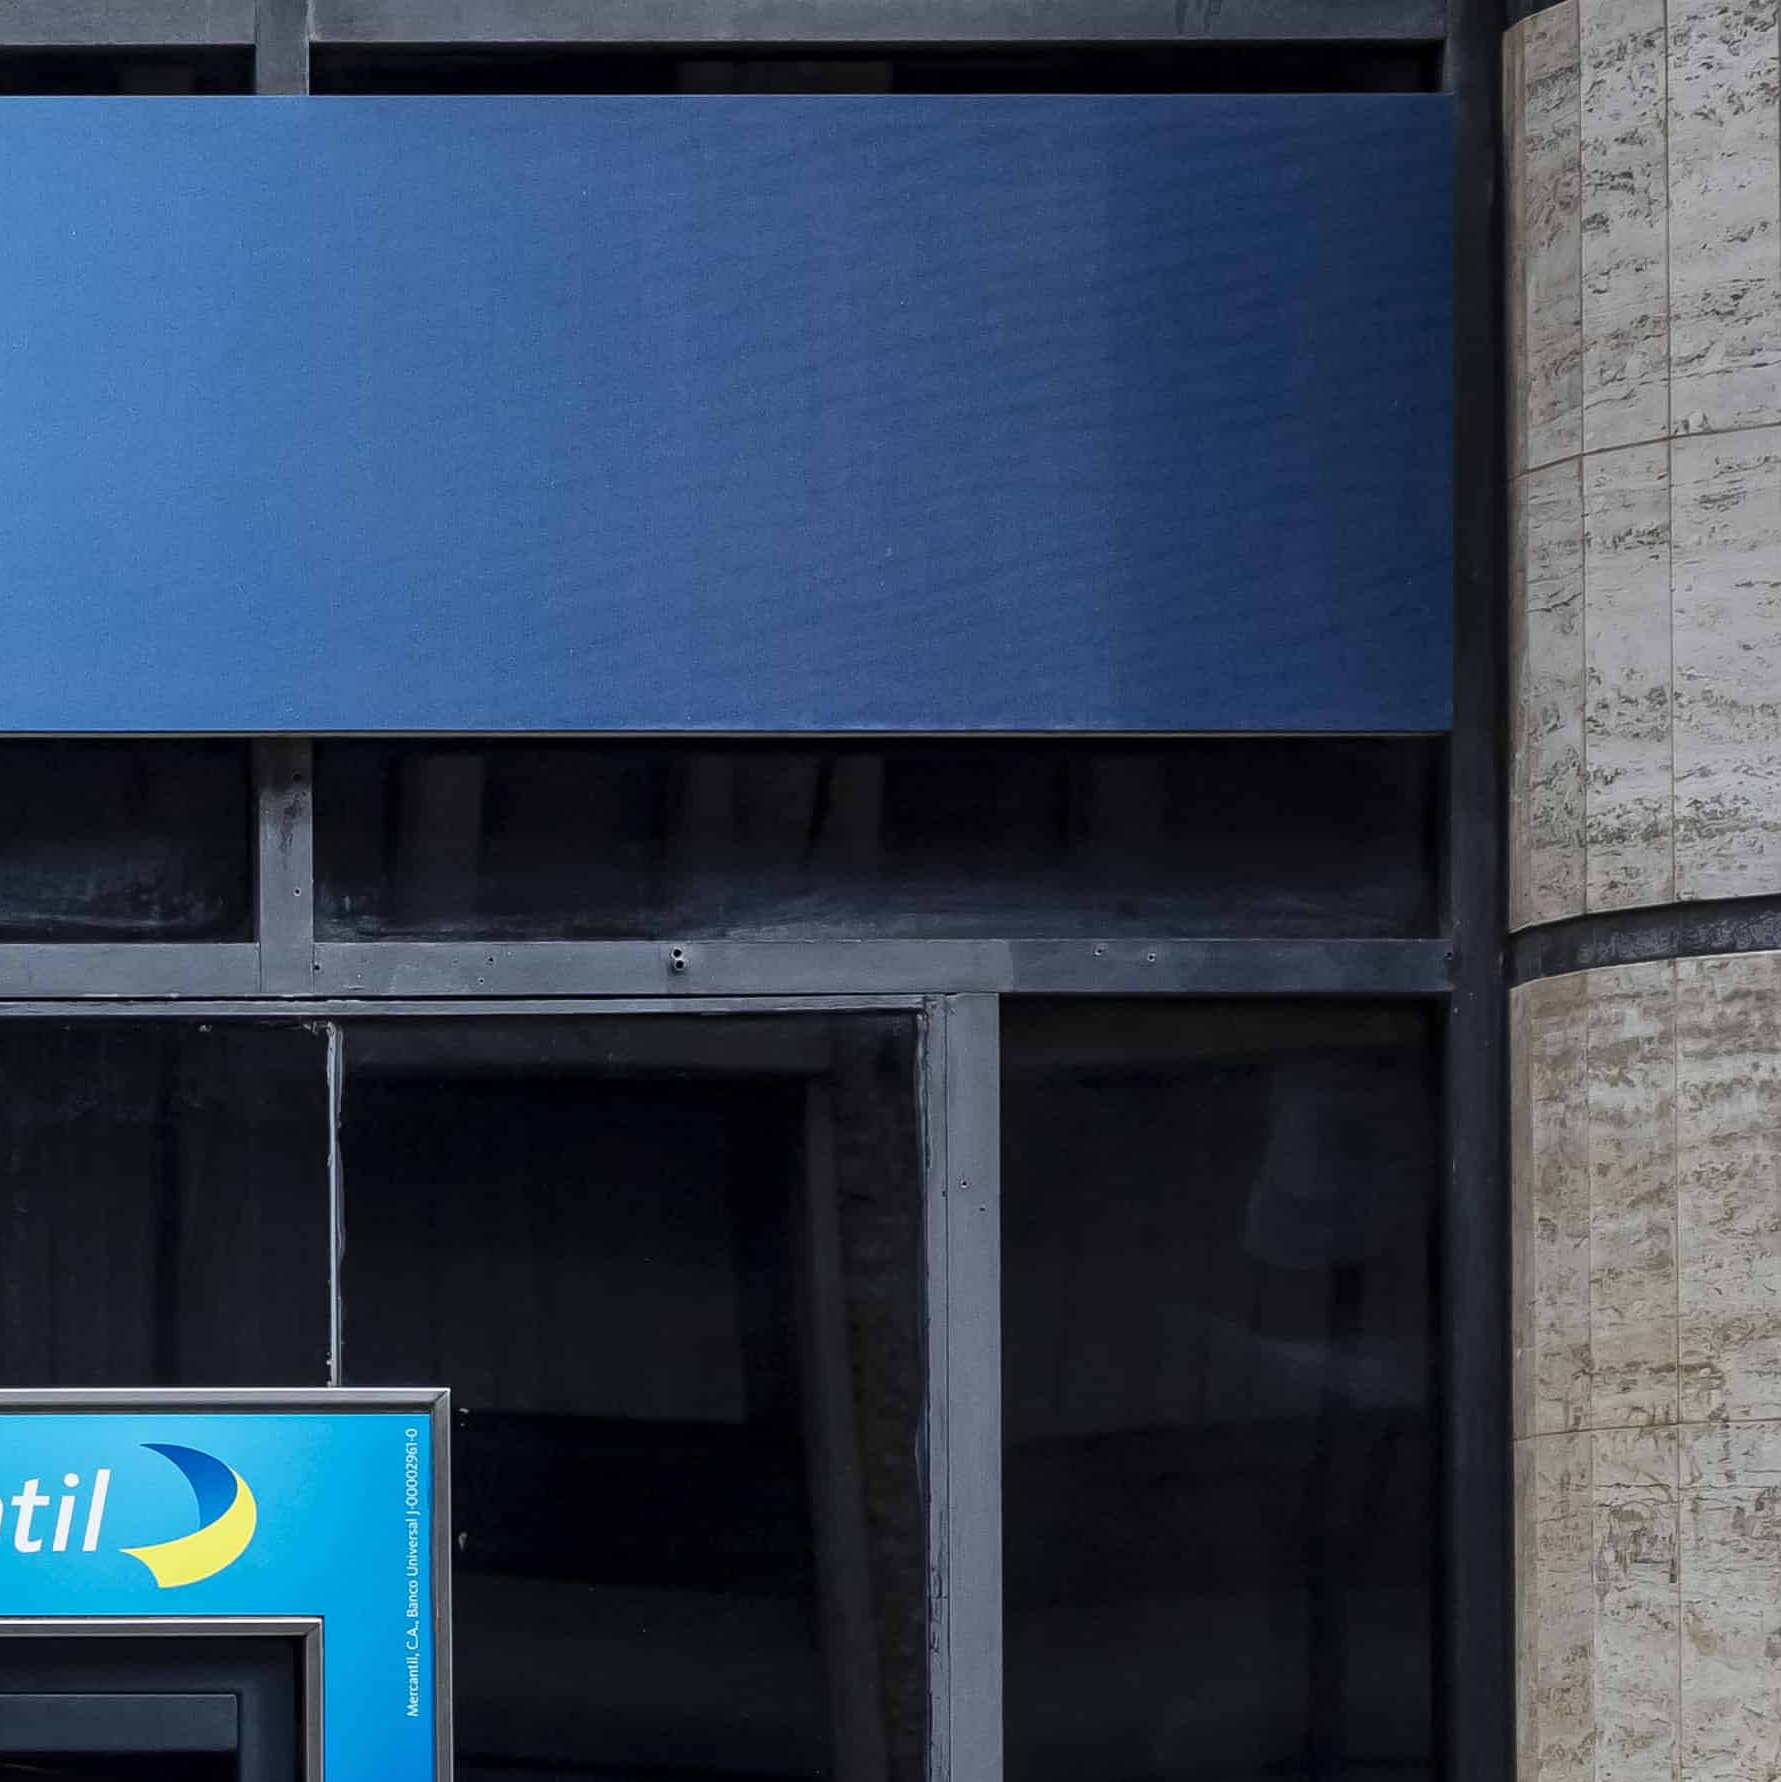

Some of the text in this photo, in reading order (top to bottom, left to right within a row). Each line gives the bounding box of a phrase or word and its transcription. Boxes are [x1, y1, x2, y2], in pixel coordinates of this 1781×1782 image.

[405, 1427, 421, 1516] J-00002961-0
[405, 1518, 419, 1577] Universal
[405, 1579, 419, 1618] Banco
[405, 1652, 421, 1717] Mercantil,
